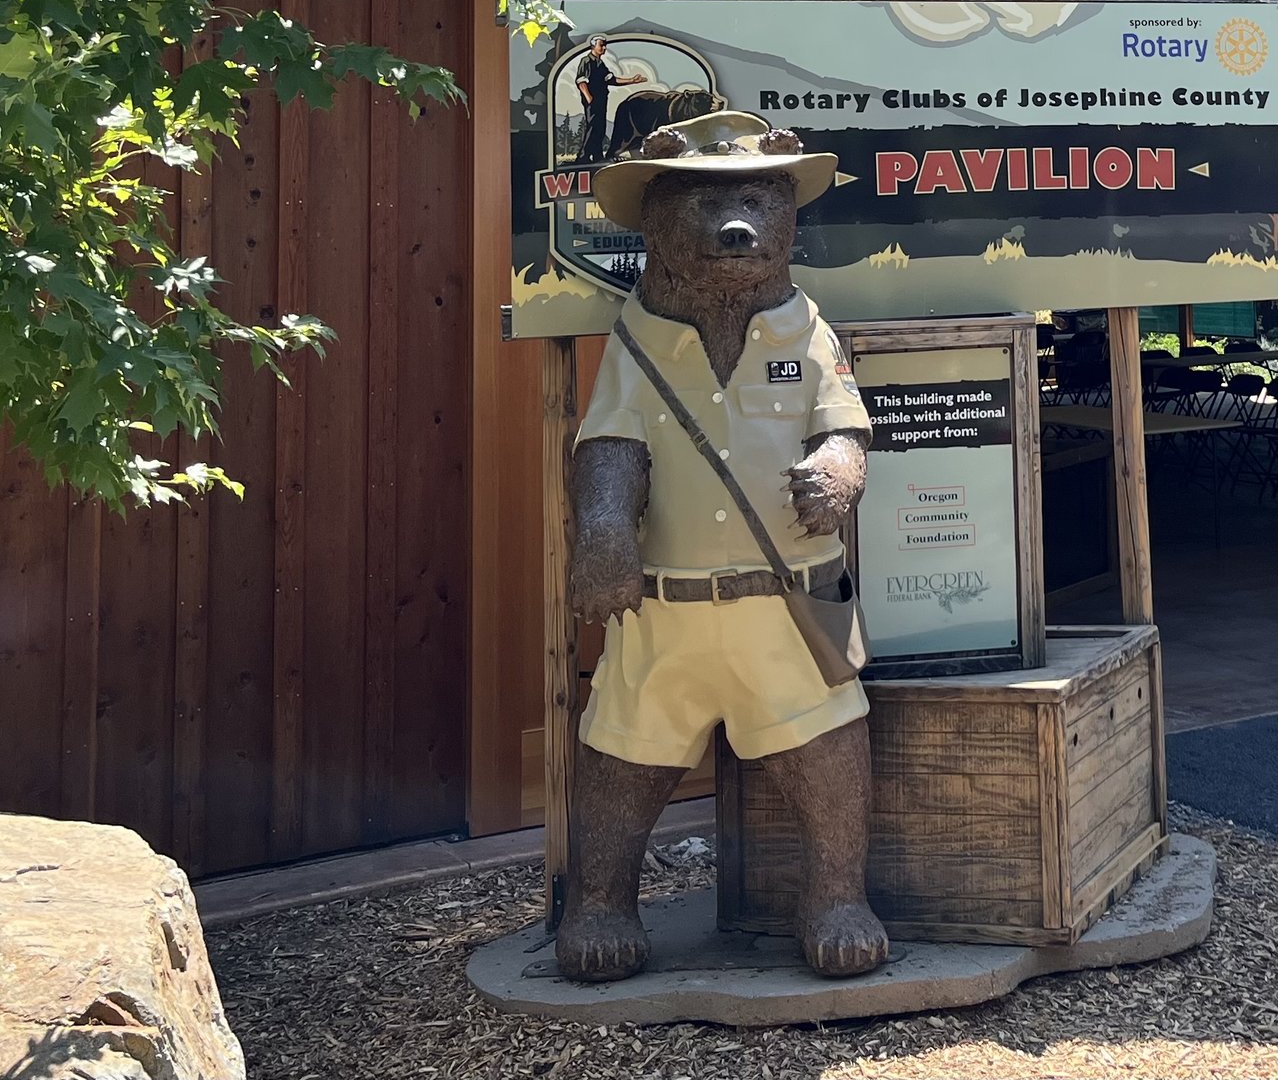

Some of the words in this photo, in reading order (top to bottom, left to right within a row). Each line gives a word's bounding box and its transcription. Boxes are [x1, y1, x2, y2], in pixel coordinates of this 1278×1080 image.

[1129, 17, 1183, 29] sponsored
[1186, 17, 1202, 29] by:
[1122, 33, 1208, 62] Rotary
[760, 89, 871, 113] Rotary
[882, 88, 967, 110] Clubs
[977, 88, 1008, 108] of
[1017, 88, 1163, 110] Josephine
[1172, 87, 1270, 110] County
[875, 146, 1176, 196] PAVILION
[780, 362, 798, 376] JD
[873, 394, 901, 407] This
[904, 392, 954, 407] building
[957, 390, 992, 403] made
[868, 411, 911, 425] ossible
[914, 410, 941, 422] with
[944, 406, 1006, 421] additional
[891, 427, 941, 443] support
[943, 426, 978, 438] from:
[918, 492, 958, 503] Oregon
[905, 510, 969, 523] Community
[906, 531, 969, 544] Foundation
[886, 570, 984, 594] EVERGREEN
